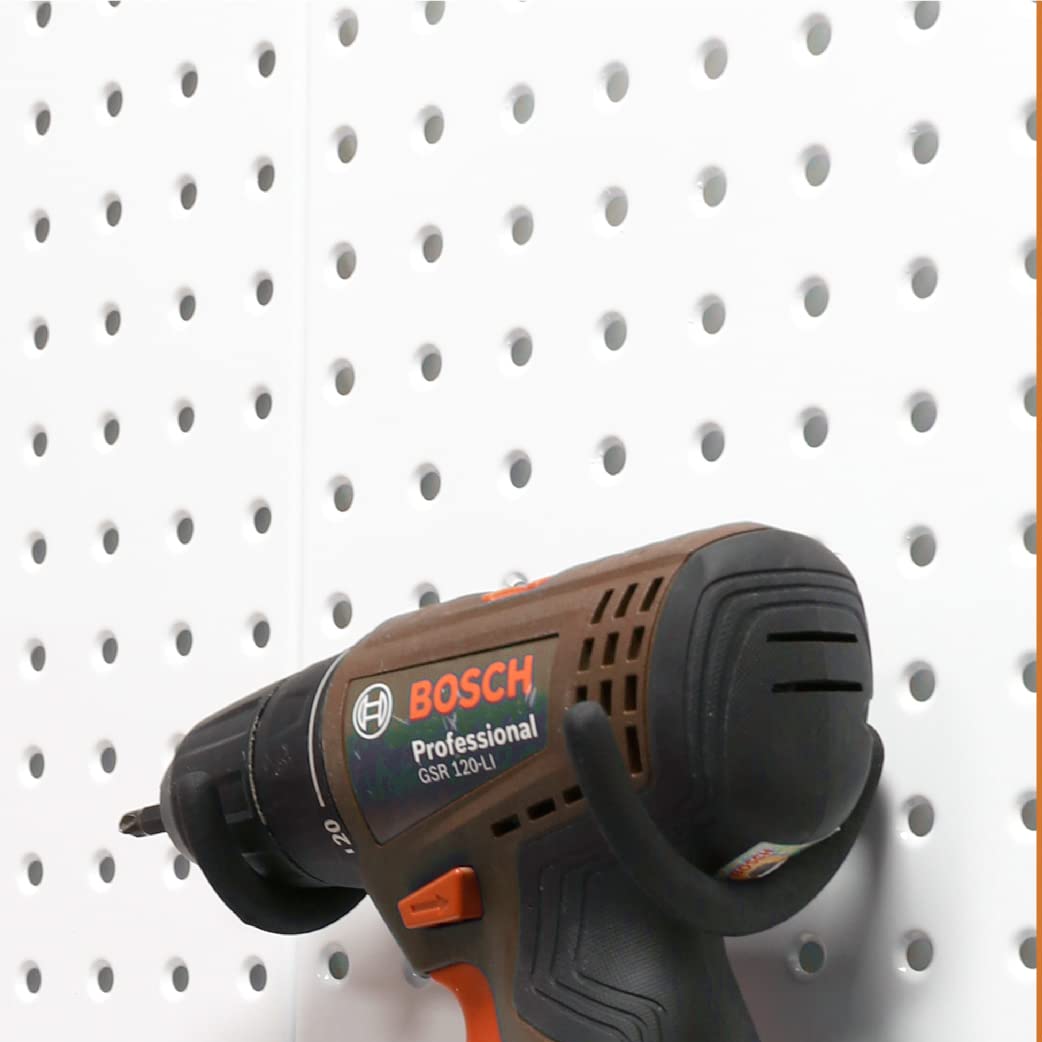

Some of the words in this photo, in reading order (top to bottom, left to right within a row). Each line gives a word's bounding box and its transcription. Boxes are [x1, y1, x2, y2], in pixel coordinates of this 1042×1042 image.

[410, 655, 534, 721] BOSCH
[411, 713, 539, 763] Professional
[418, 765, 450, 784] GSR
[452, 753, 497, 777] 120-LI
